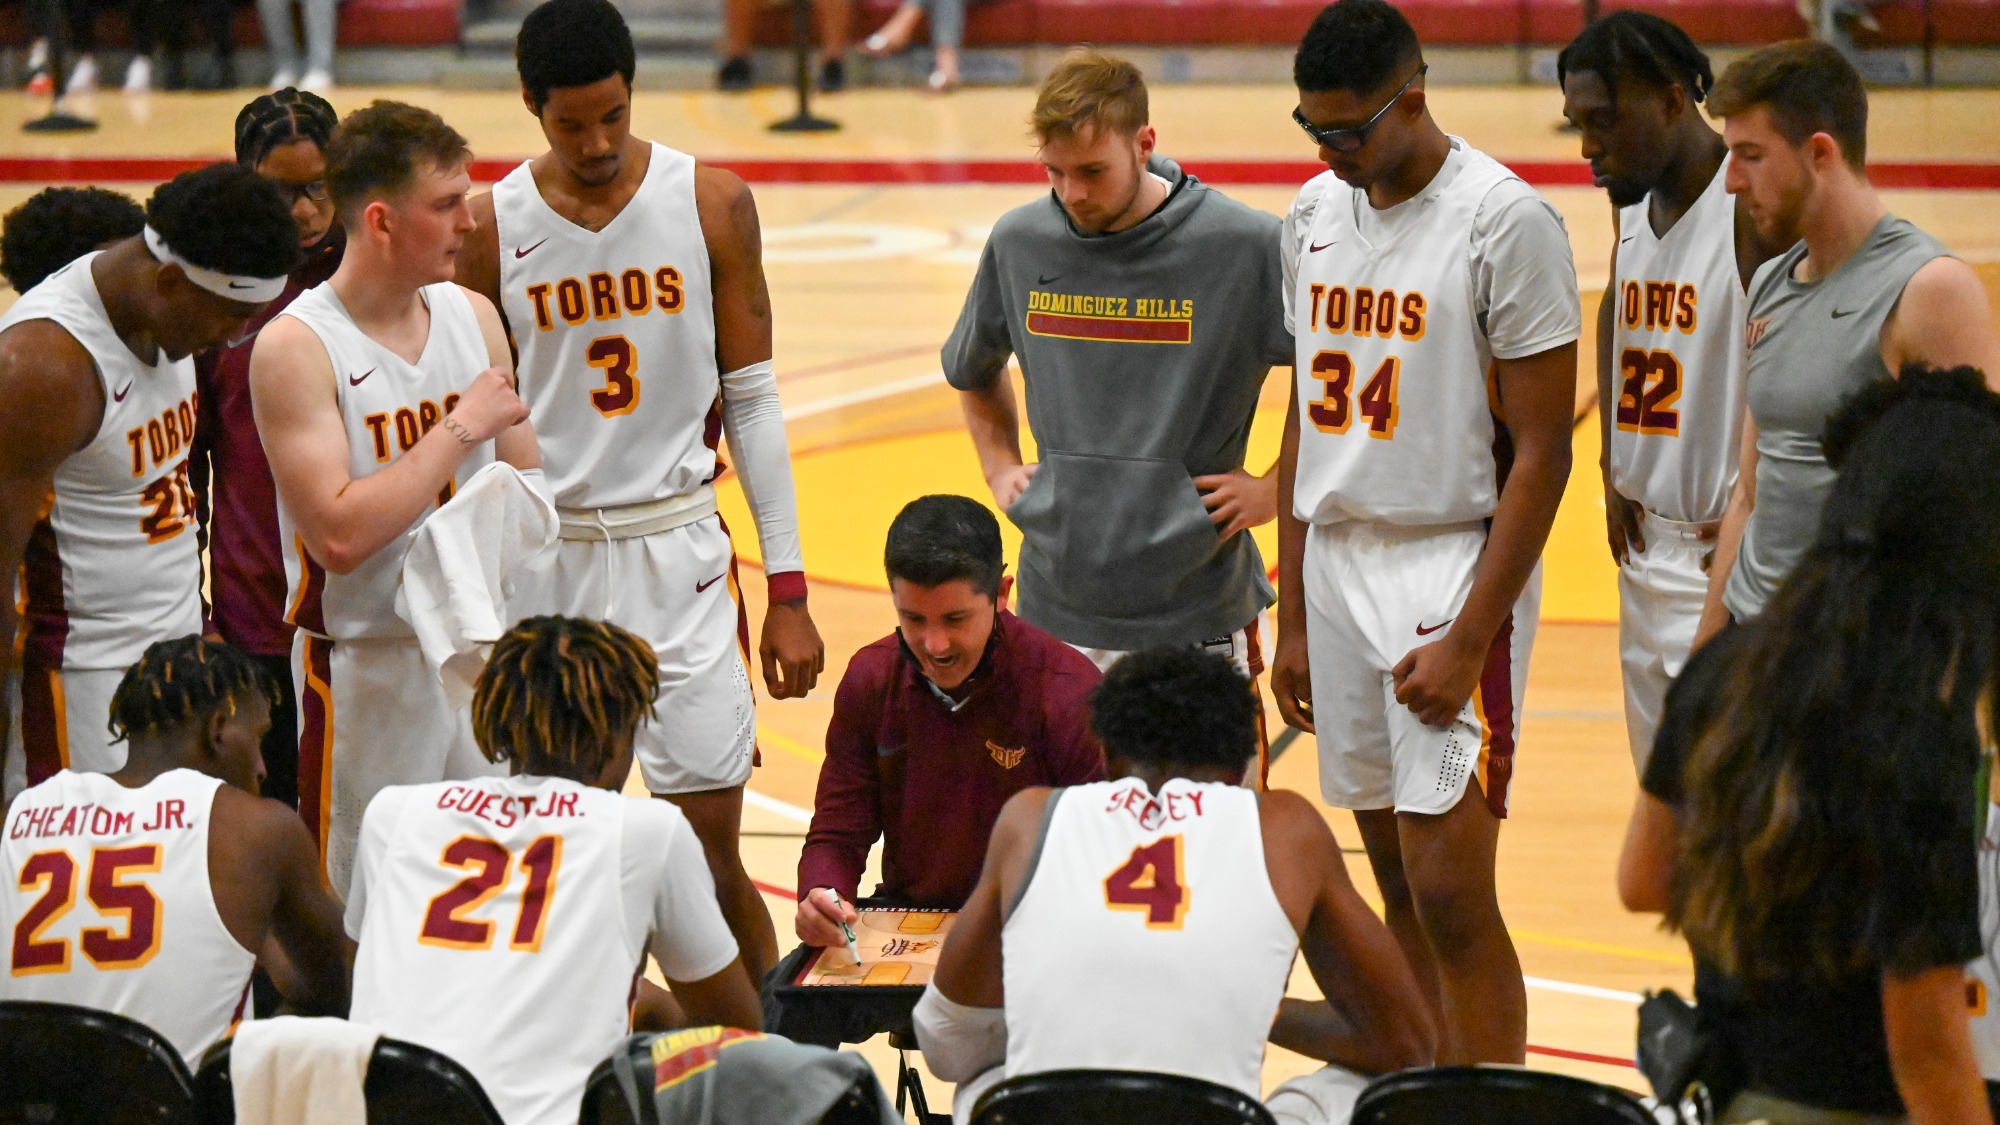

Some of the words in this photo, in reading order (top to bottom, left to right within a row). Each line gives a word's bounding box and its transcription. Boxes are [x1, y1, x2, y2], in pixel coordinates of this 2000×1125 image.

[526, 265, 685, 332] TOROS
[1028, 291, 1127, 316] DOMINGUEZ
[1136, 298, 1193, 318] HILLS
[1310, 283, 1427, 342] TOROS
[585, 334, 640, 419] 3
[1307, 349, 1402, 440] 34
[1617, 347, 1683, 438] 32
[10, 803, 135, 840] CHEATOM
[143, 799, 193, 831] JR.
[437, 786, 537, 828] GUEST
[536, 791, 585, 817] JR.
[11, 842, 164, 979] 25
[417, 833, 564, 953] 21
[1102, 833, 1191, 931] 4
